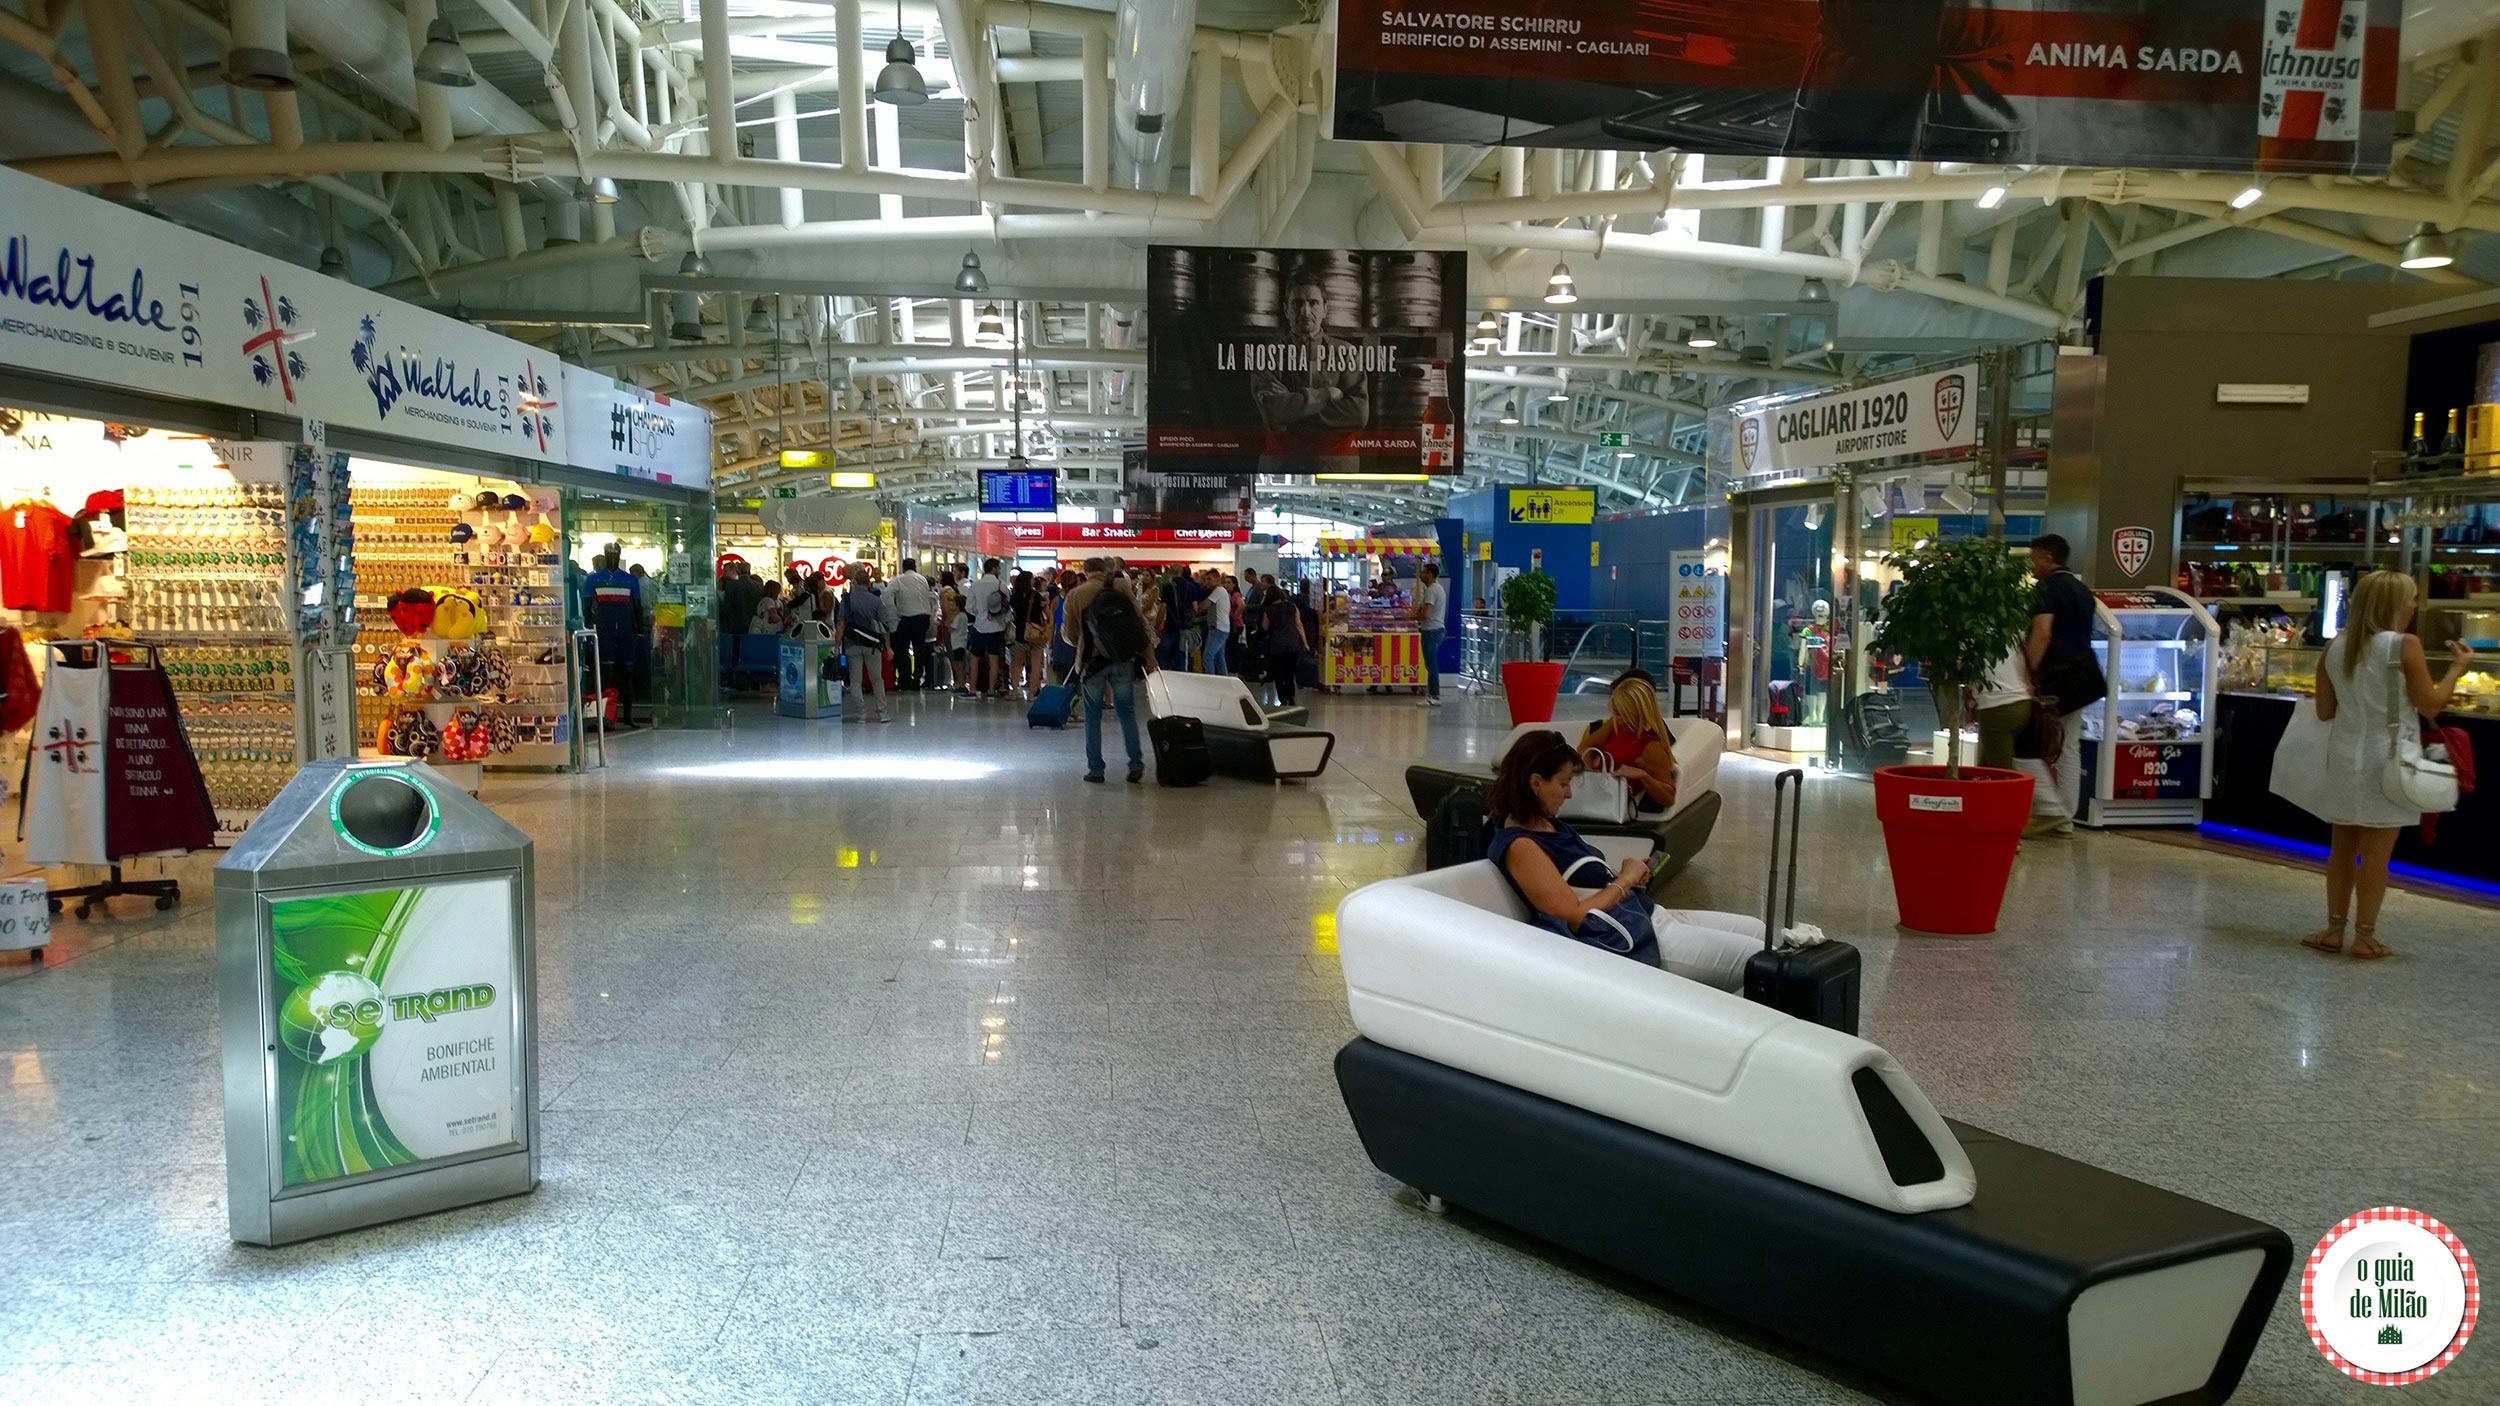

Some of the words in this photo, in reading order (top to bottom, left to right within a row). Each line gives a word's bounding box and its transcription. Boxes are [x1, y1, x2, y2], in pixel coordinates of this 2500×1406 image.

[1381, 10, 1495, 31] SALVATORE
[1500, 16, 1582, 35] SCHIRRU
[1381, 32, 1465, 48] BIRRIFICIO
[1469, 36, 1485, 48] DI
[1490, 37, 1562, 52] ASSEMINI
[1576, 41, 1649, 55] CAGLIARI
[2025, 42, 2128, 69] ANIMA
[2136, 47, 2243, 74] SARDA
[2275, 78, 2307, 88] ANIMA
[2310, 80, 2344, 90] SARDA
[179, 282, 203, 368] 1991
[118, 341, 175, 364] SOUVENIR
[1217, 343, 1236, 370] LA
[1244, 343, 1308, 371] NOSTRA
[1317, 344, 1397, 373] PASSIONE
[400, 345, 498, 411] Waltale
[498, 374, 512, 435] 1991
[404, 406, 460, 426] MERCHANDISING
[467, 419, 497, 433] SOUVENIR
[611, 402, 633, 454] #1
[1777, 401, 1857, 444] CAGLIARI
[1861, 391, 1908, 430] 1920
[633, 427, 663, 459] SHOP
[1350, 439, 1382, 448] ANIMA
[1384, 439, 1417, 449] SARDA
[1835, 434, 1875, 455] AIRPORT
[1876, 429, 1907, 447] STORE
[1192, 475, 1228, 489] PASSIONE
[1554, 499, 1593, 507] Ascensore
[1082, 526, 1101, 537] Bar
[1335, 664, 1388, 679] SWEET
[1393, 664, 1420, 679] FLY
[147, 707, 167, 718] UNA
[2129, 744, 2157, 758] Wine
[2143, 762, 2168, 775] 1920
[2132, 779, 2153, 787] Food
[2161, 779, 2181, 787] Wine
[426, 1036, 495, 1061] BONIFICHE
[420, 1056, 496, 1083] AMBIENTALI
[446, 1112, 497, 1129] www.setrand.it
